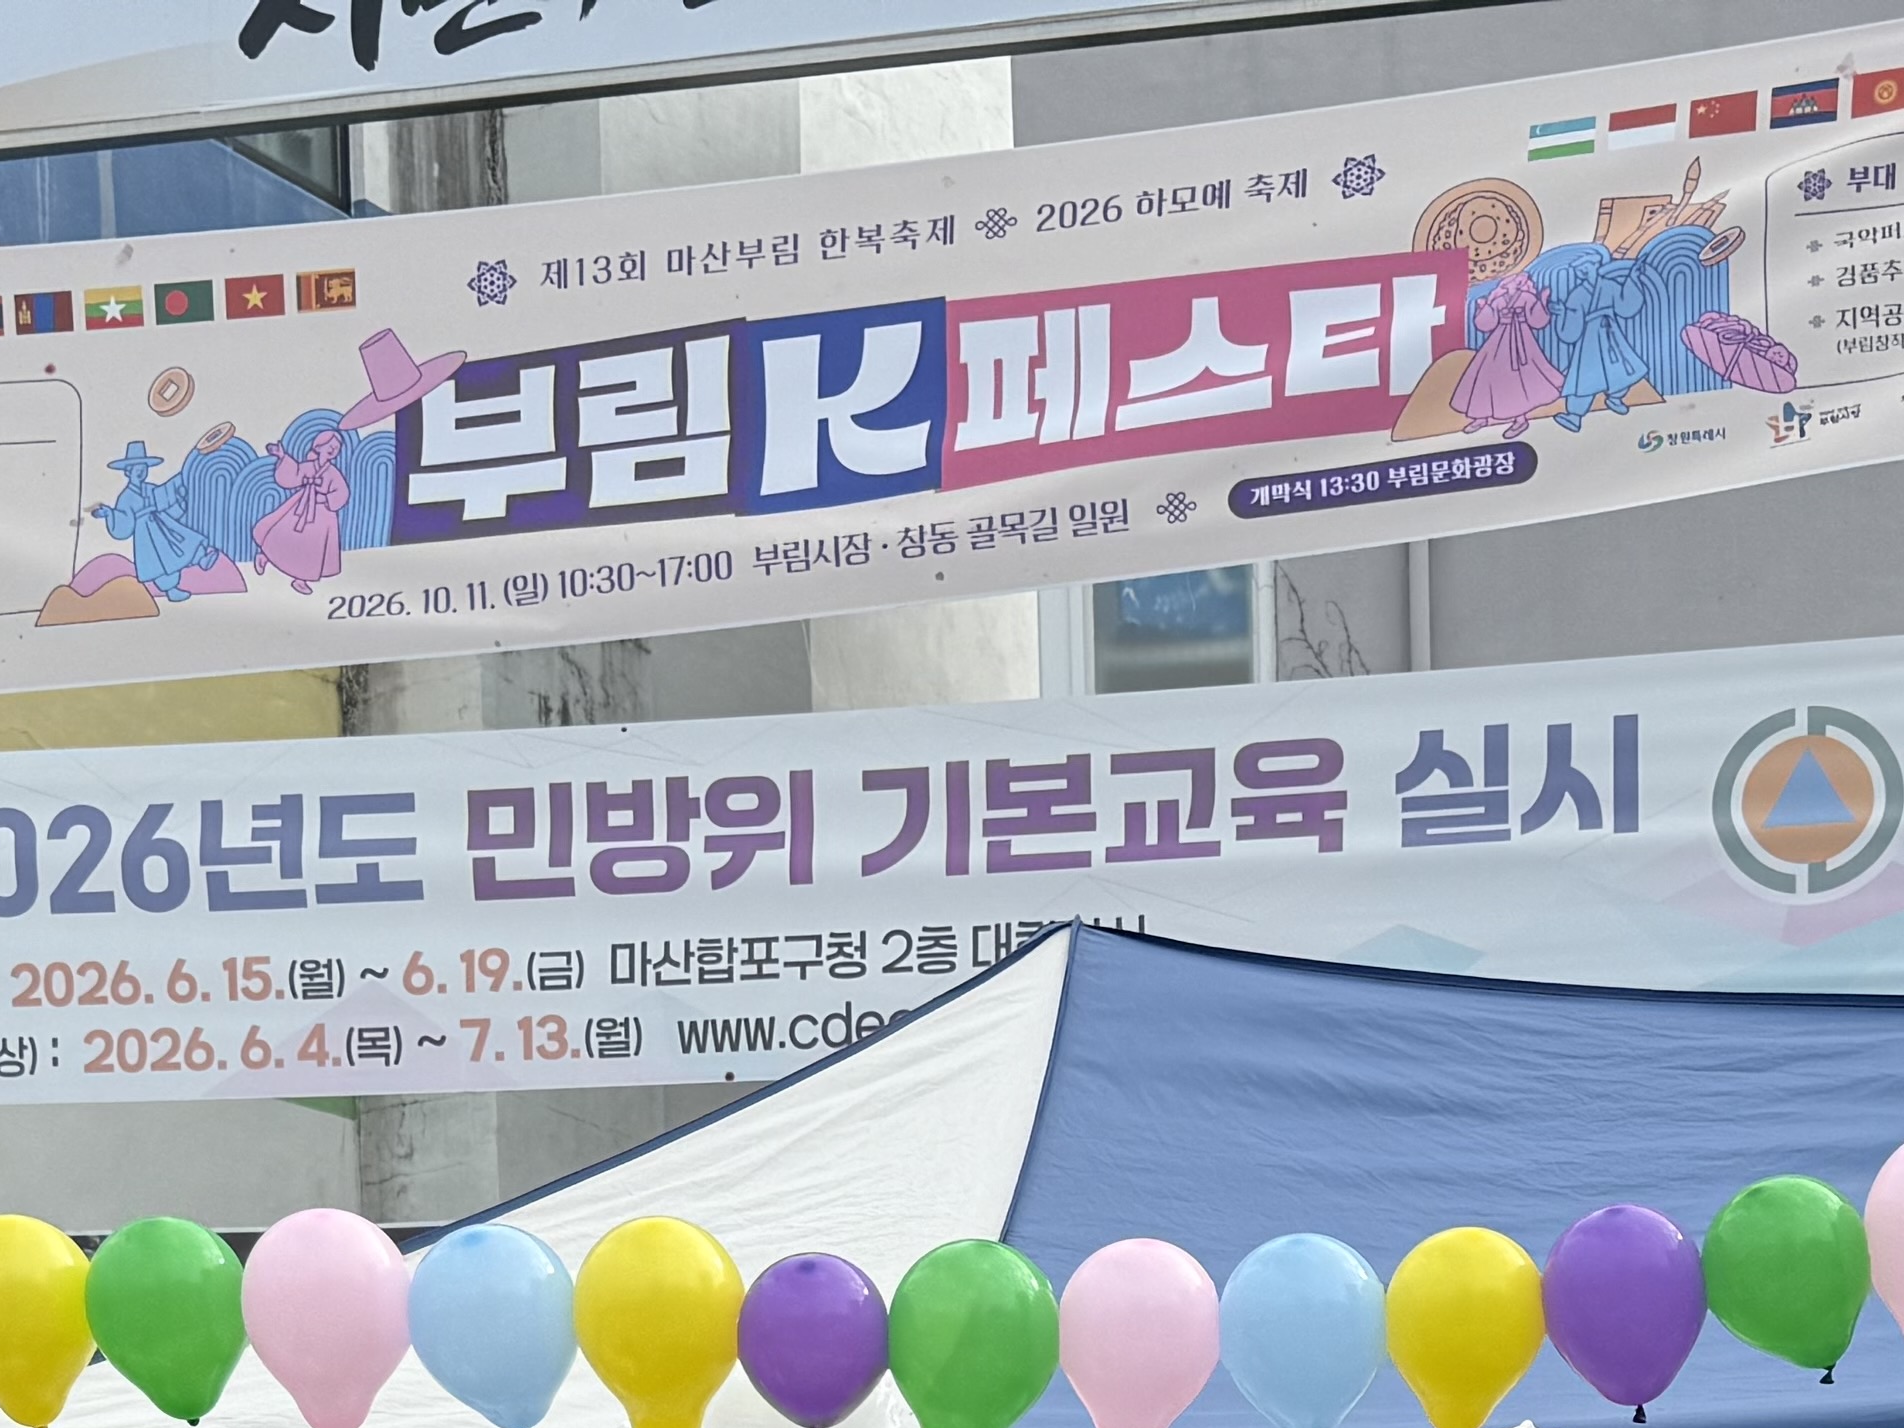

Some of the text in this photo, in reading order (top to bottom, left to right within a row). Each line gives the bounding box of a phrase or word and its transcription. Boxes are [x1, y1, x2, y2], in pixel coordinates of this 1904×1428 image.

[540, 251, 646, 289] 제13회
[667, 233, 799, 278] 마산부림
[819, 214, 956, 260] 한복축제
[1035, 194, 1122, 233] 2026
[1244, 167, 1307, 204] 축제
[1847, 162, 1897, 193] 부대
[408, 274, 1445, 522] 부림 K 페스타
[1250, 451, 1516, 507] 개막식 13:30 부림문화광장
[328, 591, 412, 621] 2026.
[504, 572, 549, 607] (일)
[558, 550, 733, 599] 10:30~17:00
[752, 532, 871, 576] 부림시장
[896, 517, 959, 560] 창동
[966, 507, 1059, 551] 골목길
[1069, 499, 1130, 539] 일원
[467, 769, 815, 902] 민방위
[862, 737, 1348, 878] 기본교육
[1396, 713, 1640, 850] 실시
[609, 931, 869, 990] 마산합포구청
[881, 926, 958, 976] 2층
